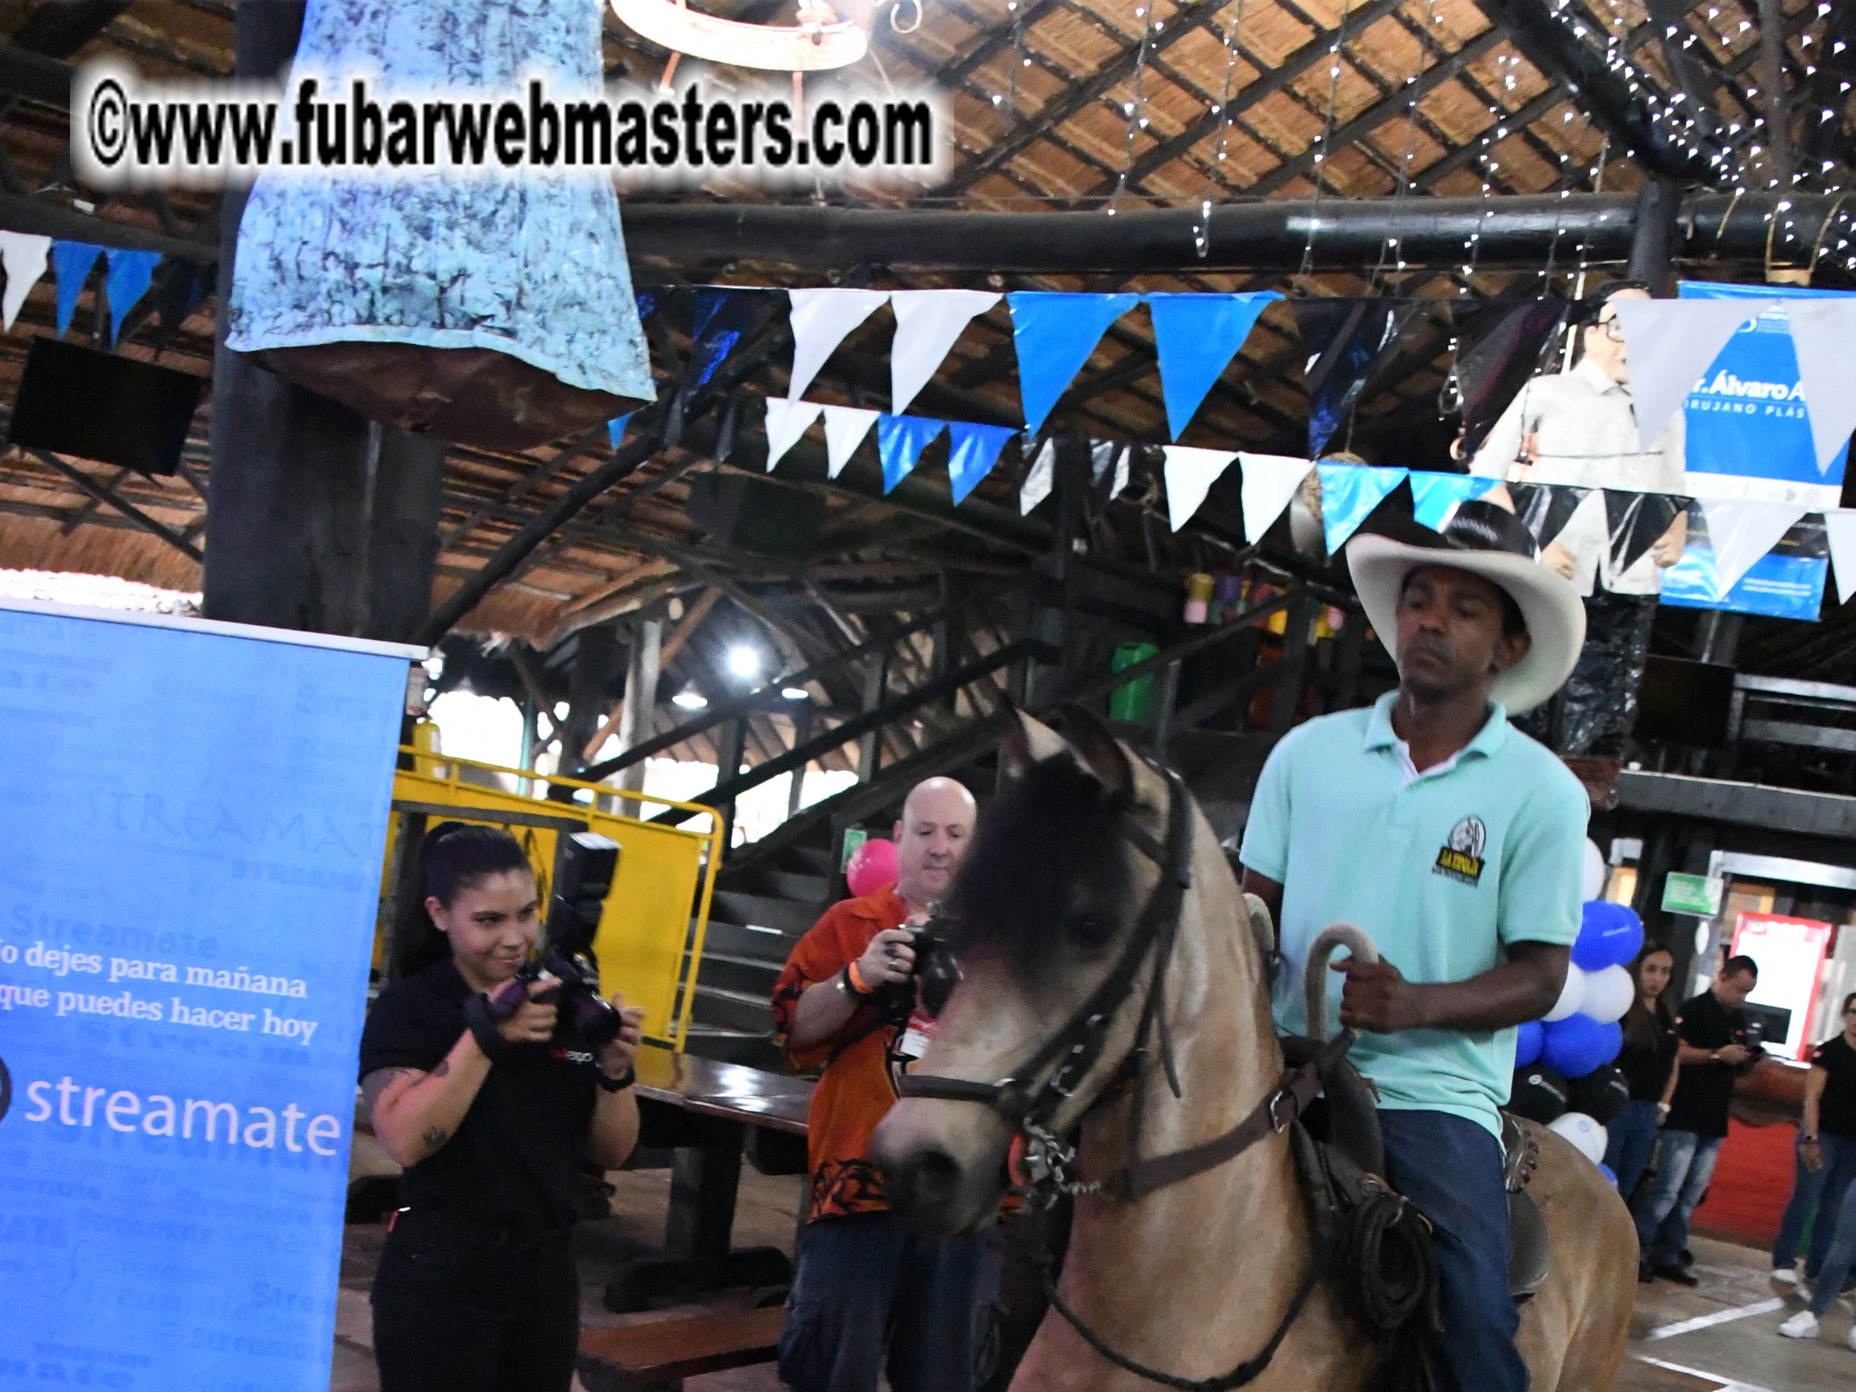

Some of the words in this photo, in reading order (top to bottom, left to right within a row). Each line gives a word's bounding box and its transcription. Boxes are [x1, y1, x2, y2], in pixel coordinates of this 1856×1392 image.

[1682, 399, 1757, 415] IRUJANO
[0, 939, 18, 964] o
[25, 941, 103, 977] dejes
[107, 956, 179, 983] para
[186, 966, 308, 999] mañana
[0, 983, 51, 1011] que
[55, 991, 164, 1022] puedes
[169, 997, 256, 1032] hacer
[261, 1008, 319, 1046] hoy
[24, 1076, 341, 1156] streamate
